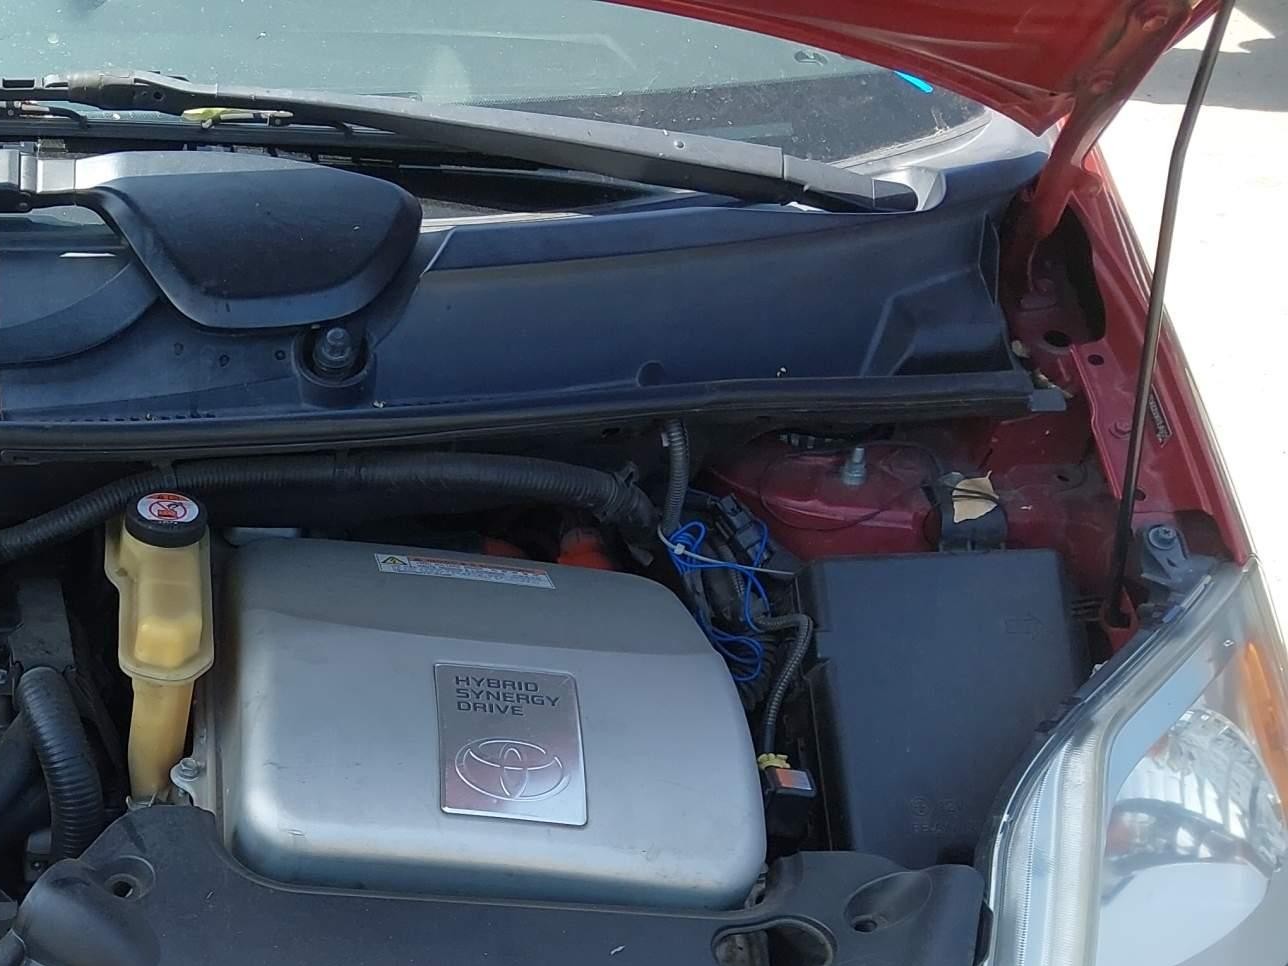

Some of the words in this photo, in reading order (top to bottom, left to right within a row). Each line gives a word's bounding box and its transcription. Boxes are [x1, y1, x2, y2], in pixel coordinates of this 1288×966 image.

[455, 675, 539, 692] HYBRID
[456, 688, 560, 707] SYNERGY
[457, 701, 524, 716] DRIVE
